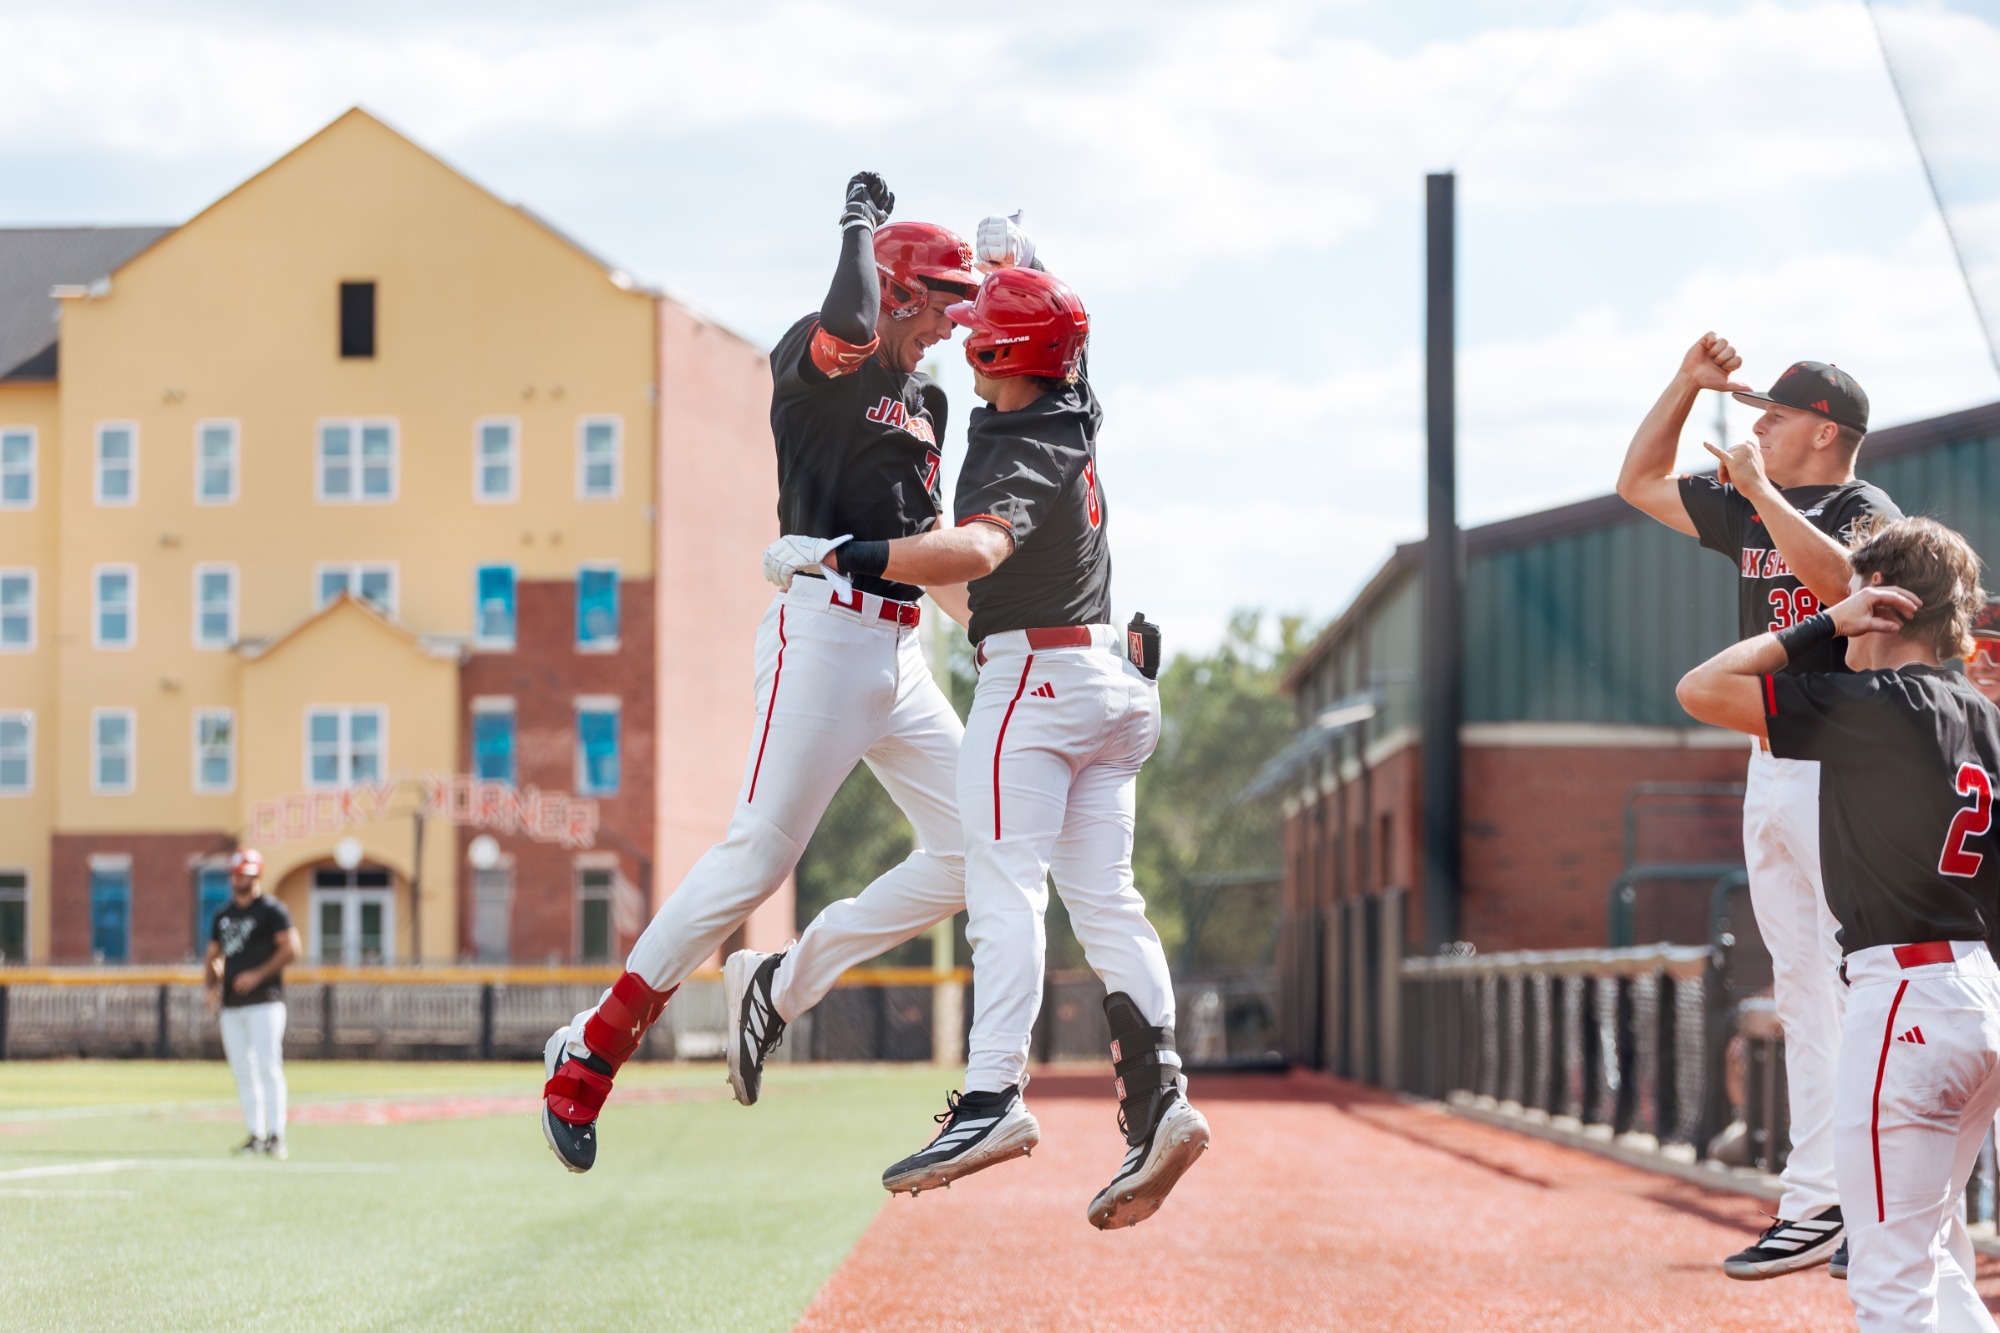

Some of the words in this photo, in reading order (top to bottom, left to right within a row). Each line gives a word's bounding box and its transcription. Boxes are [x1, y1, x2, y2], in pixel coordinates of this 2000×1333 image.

[925, 449, 941, 496] 7
[1083, 456, 1101, 531] 8
[1768, 587, 1820, 632] 38
[1938, 761, 1993, 878] 2
